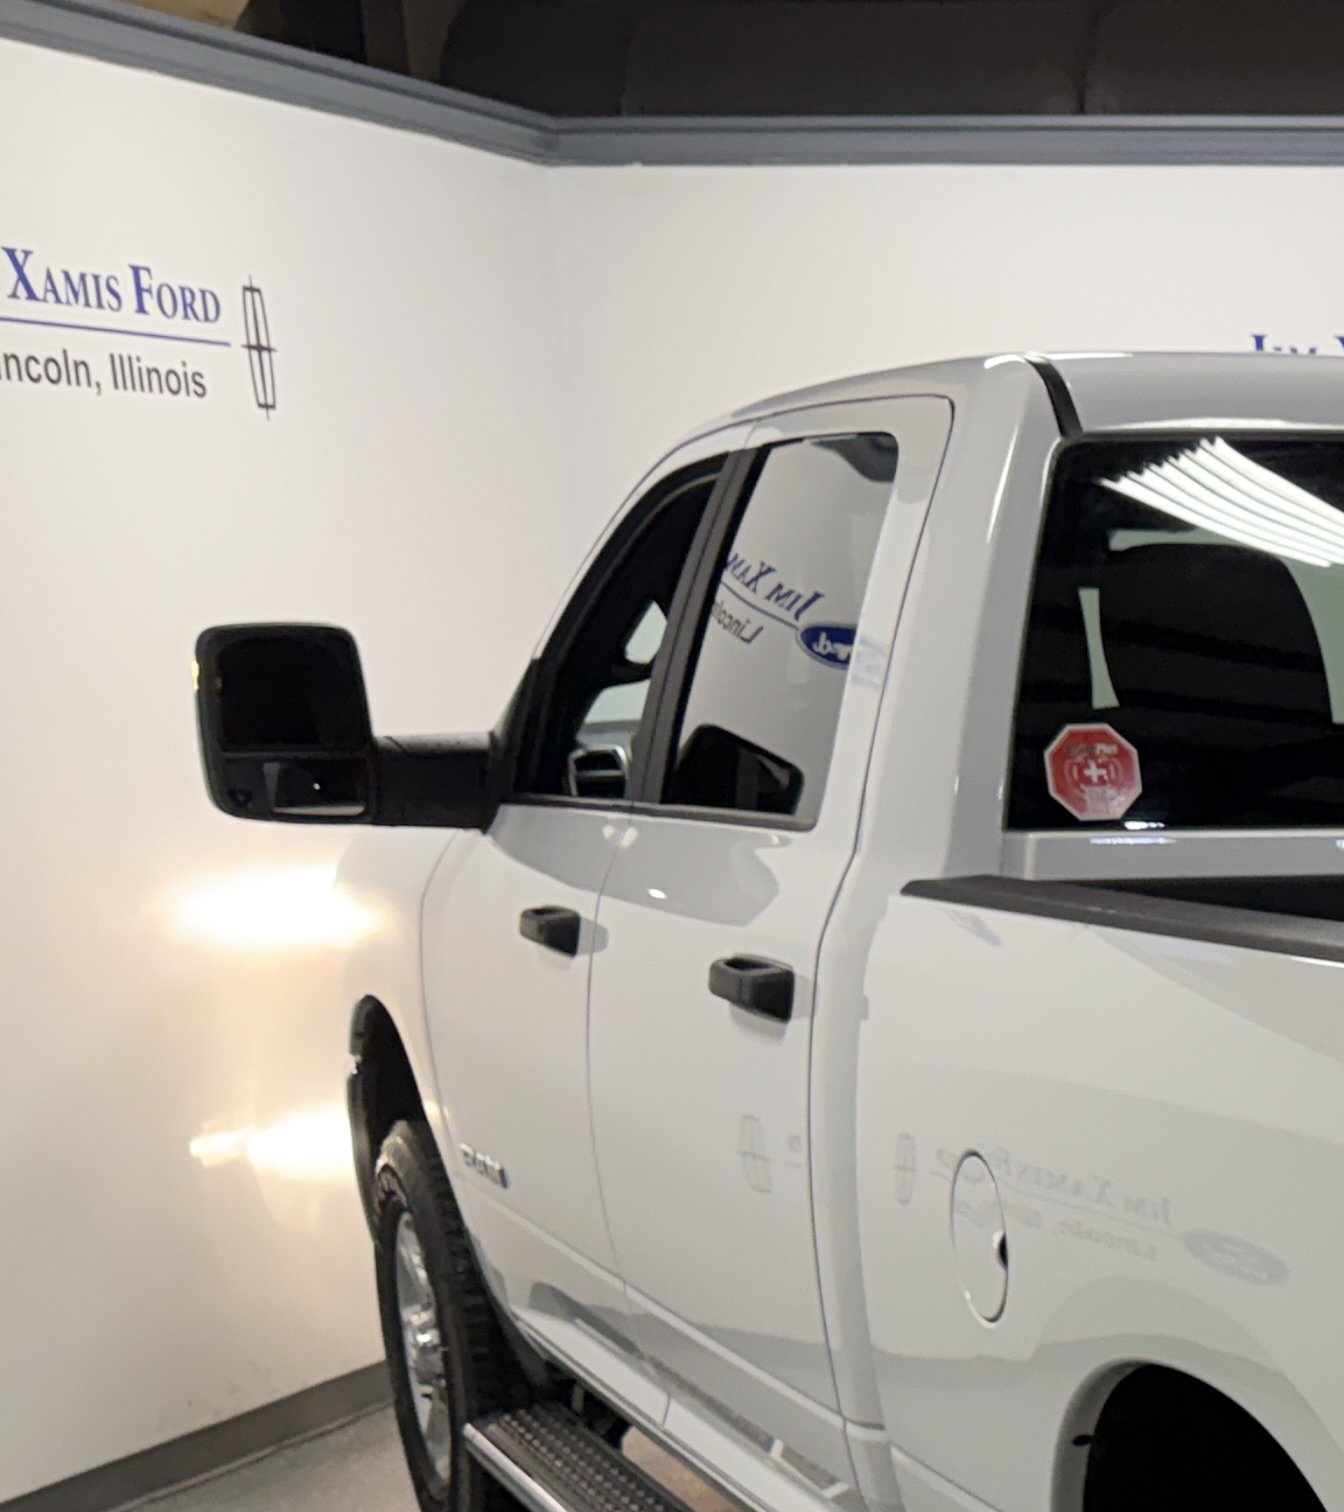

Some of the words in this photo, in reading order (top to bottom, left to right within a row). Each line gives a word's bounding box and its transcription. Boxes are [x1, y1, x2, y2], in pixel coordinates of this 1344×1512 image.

[1, 246, 123, 312] XAMIS
[128, 264, 222, 323] FORD
[0, 348, 102, 396] ncoln,
[109, 352, 208, 398] Illinois
